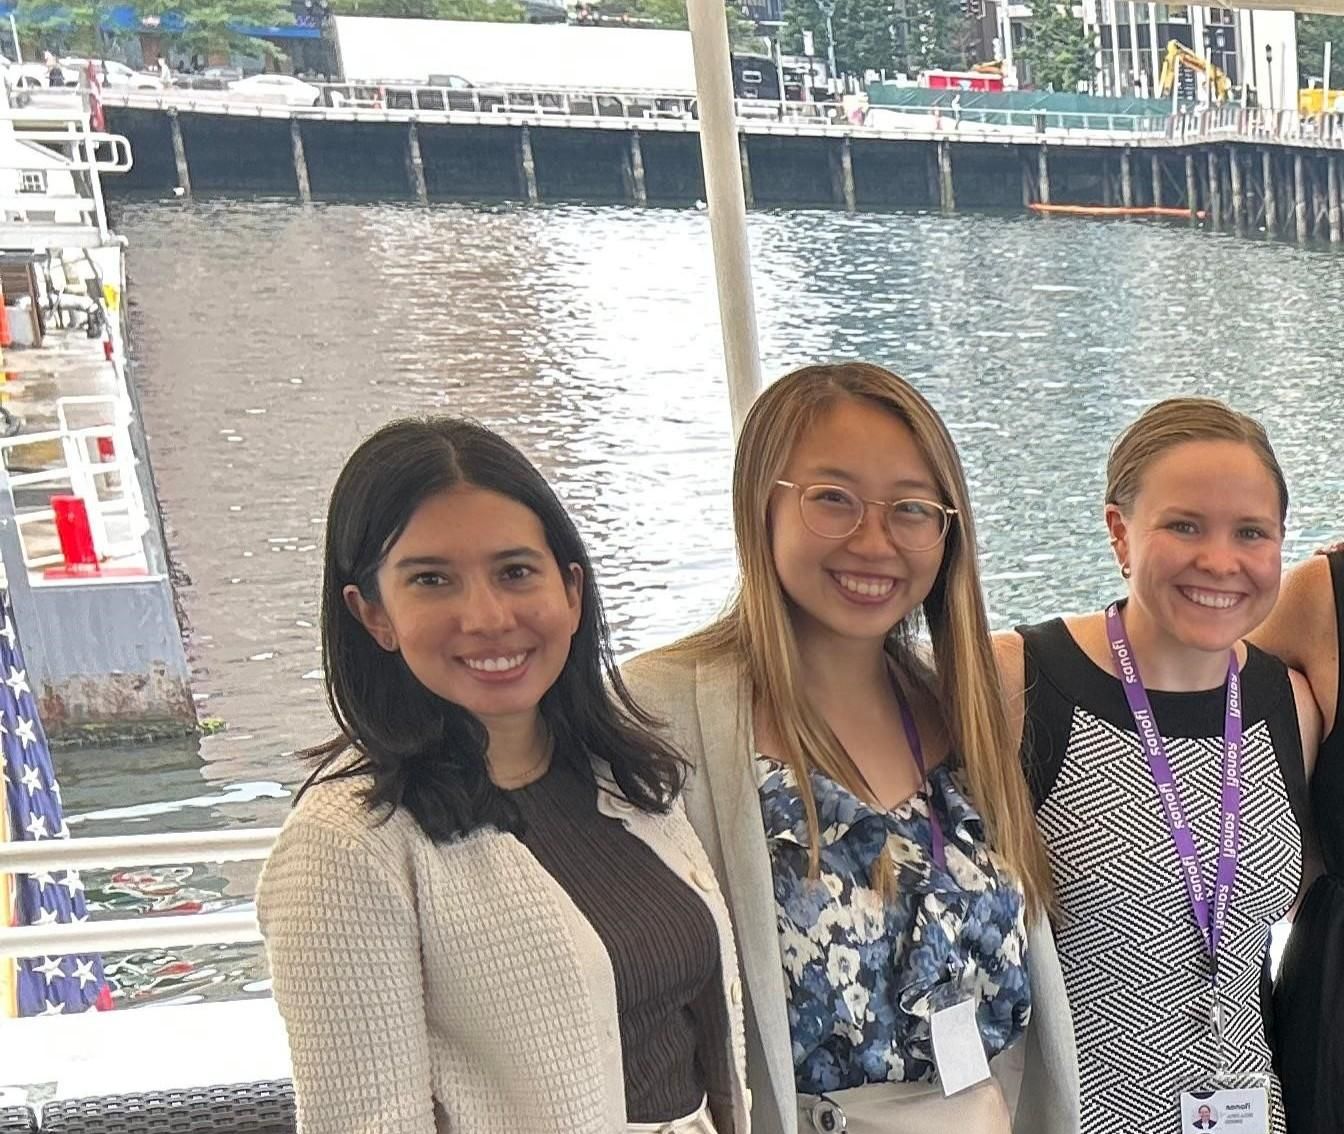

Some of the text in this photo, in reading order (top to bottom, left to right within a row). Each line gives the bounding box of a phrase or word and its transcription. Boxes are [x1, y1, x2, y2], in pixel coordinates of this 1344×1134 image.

[1111, 639, 1138, 684] sanofi
[1229, 673, 1241, 719] sanofi
[1133, 710, 1161, 756] sanofi
[1226, 742, 1240, 787] sanofi
[1159, 783, 1186, 829] sanofi
[1222, 812, 1236, 858] sanofi
[1182, 855, 1205, 901] sanofi
